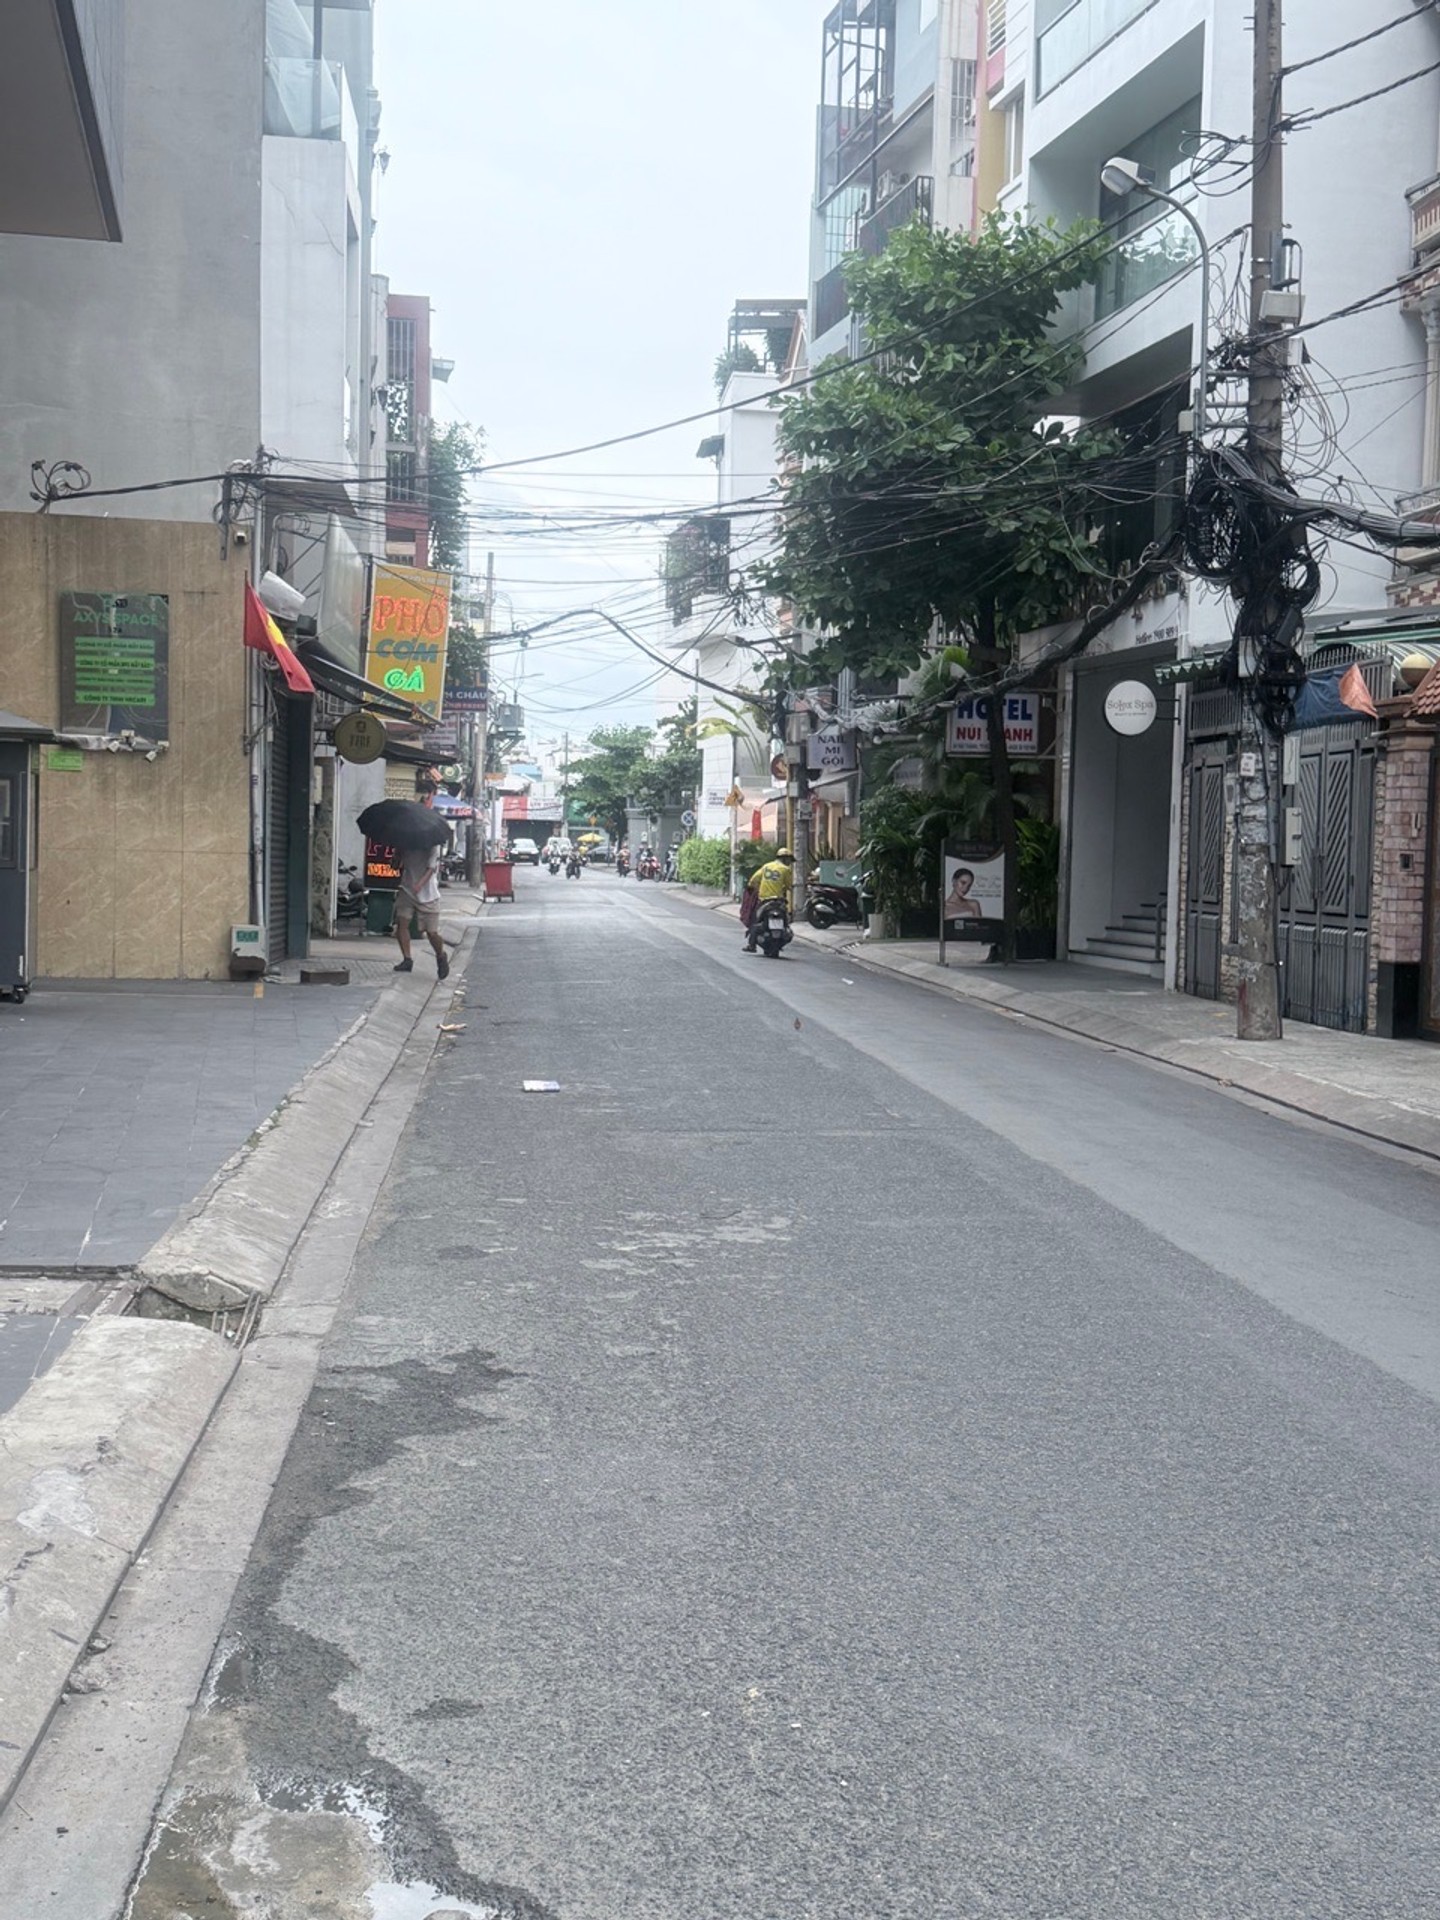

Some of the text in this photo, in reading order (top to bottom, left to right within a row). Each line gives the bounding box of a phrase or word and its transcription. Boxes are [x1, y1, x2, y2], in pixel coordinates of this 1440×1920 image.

[115, 613, 158, 625] SPACE
[373, 587, 448, 637] PHỞ
[957, 697, 1032, 720] HOEL
[1134, 699, 1154, 711] Spa
